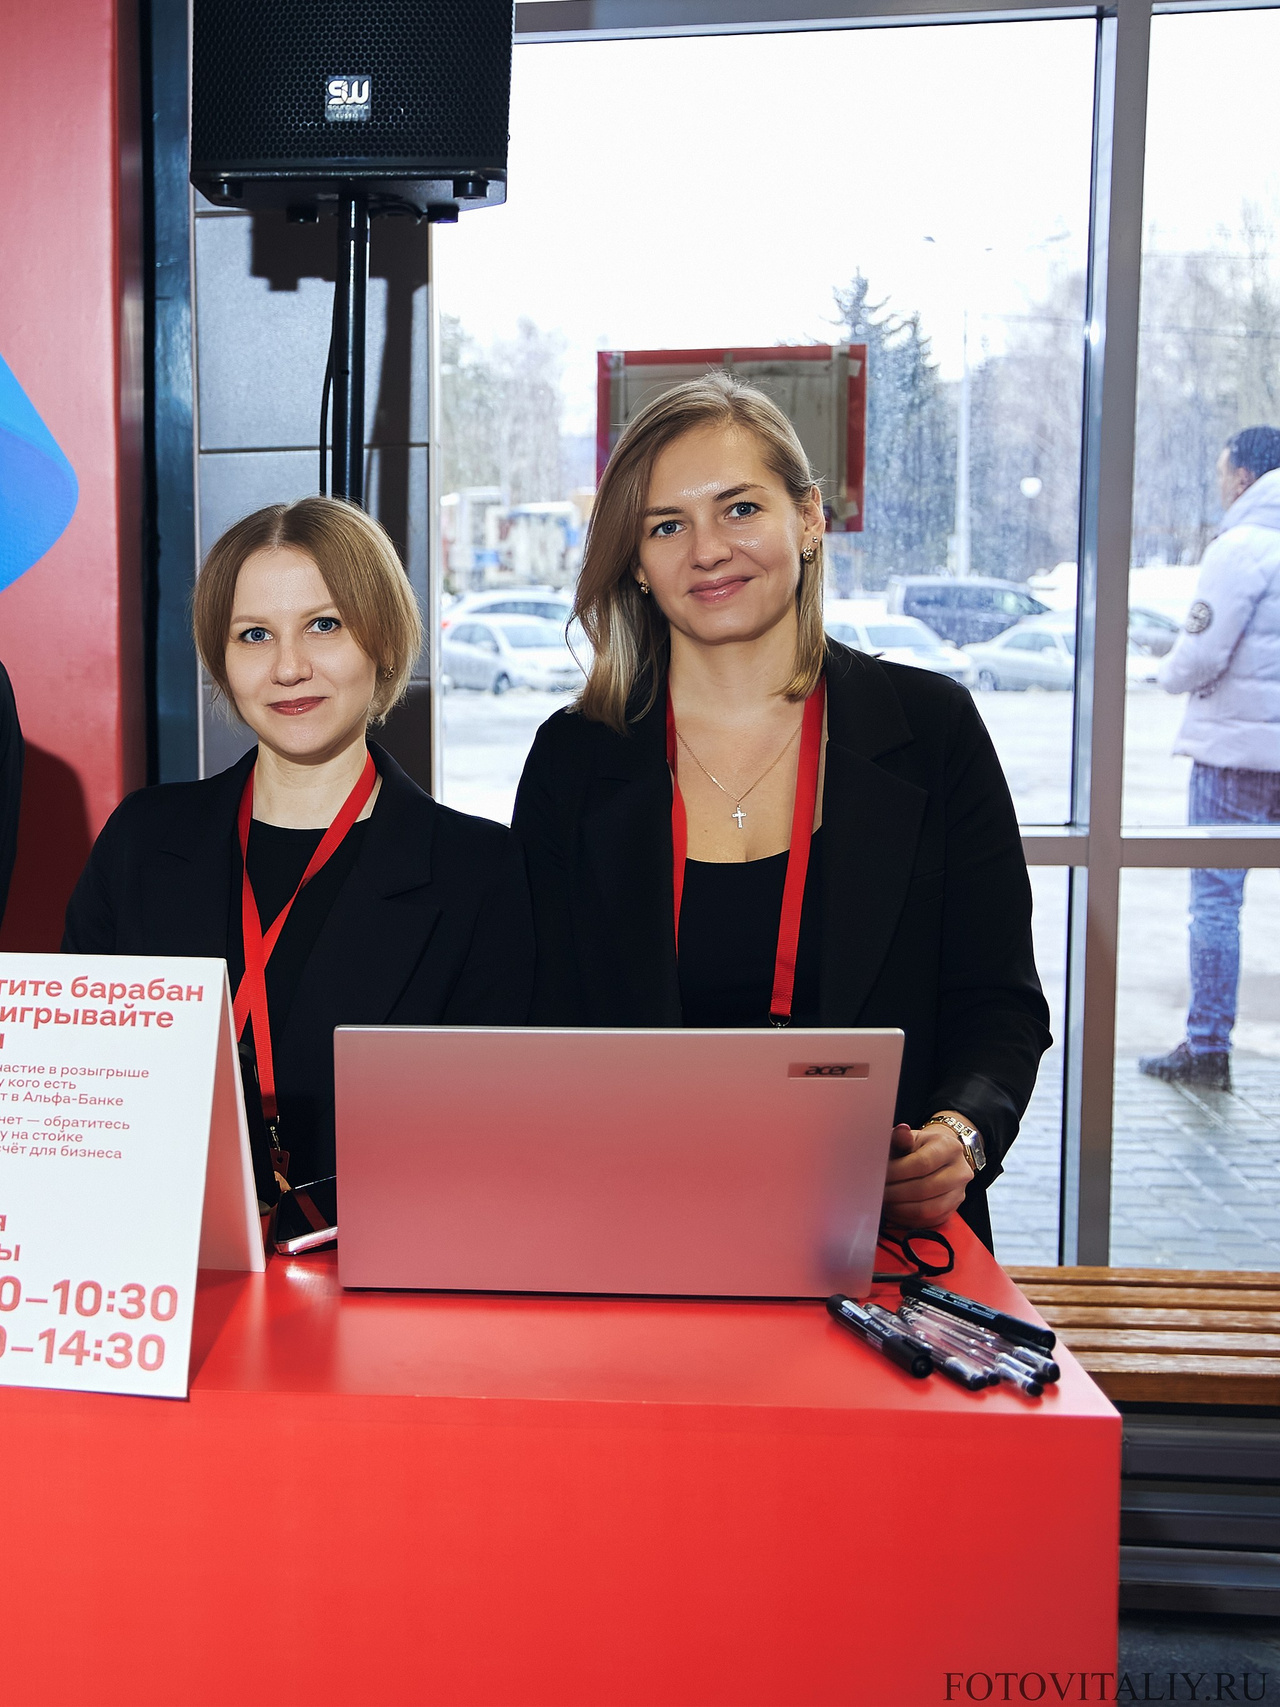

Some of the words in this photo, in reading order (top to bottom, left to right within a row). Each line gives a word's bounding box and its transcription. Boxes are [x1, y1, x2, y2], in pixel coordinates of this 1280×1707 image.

[70, 974, 204, 1006] барабан
[48, 1065, 57, 1075] в
[60, 1066, 150, 1080] розыгрыше
[804, 1065, 854, 1076] acer
[7, 1078, 41, 1089] кого
[43, 1079, 77, 1090] есть
[11, 1092, 20, 1102] в
[22, 1090, 124, 1107] Альфа-Банке
[43, 1115, 132, 1129] обратитесь
[11, 1130, 29, 1141] на
[31, 1131, 84, 1143] стойке
[28, 1146, 57, 1158] для
[60, 1144, 122, 1160] бизнеса
